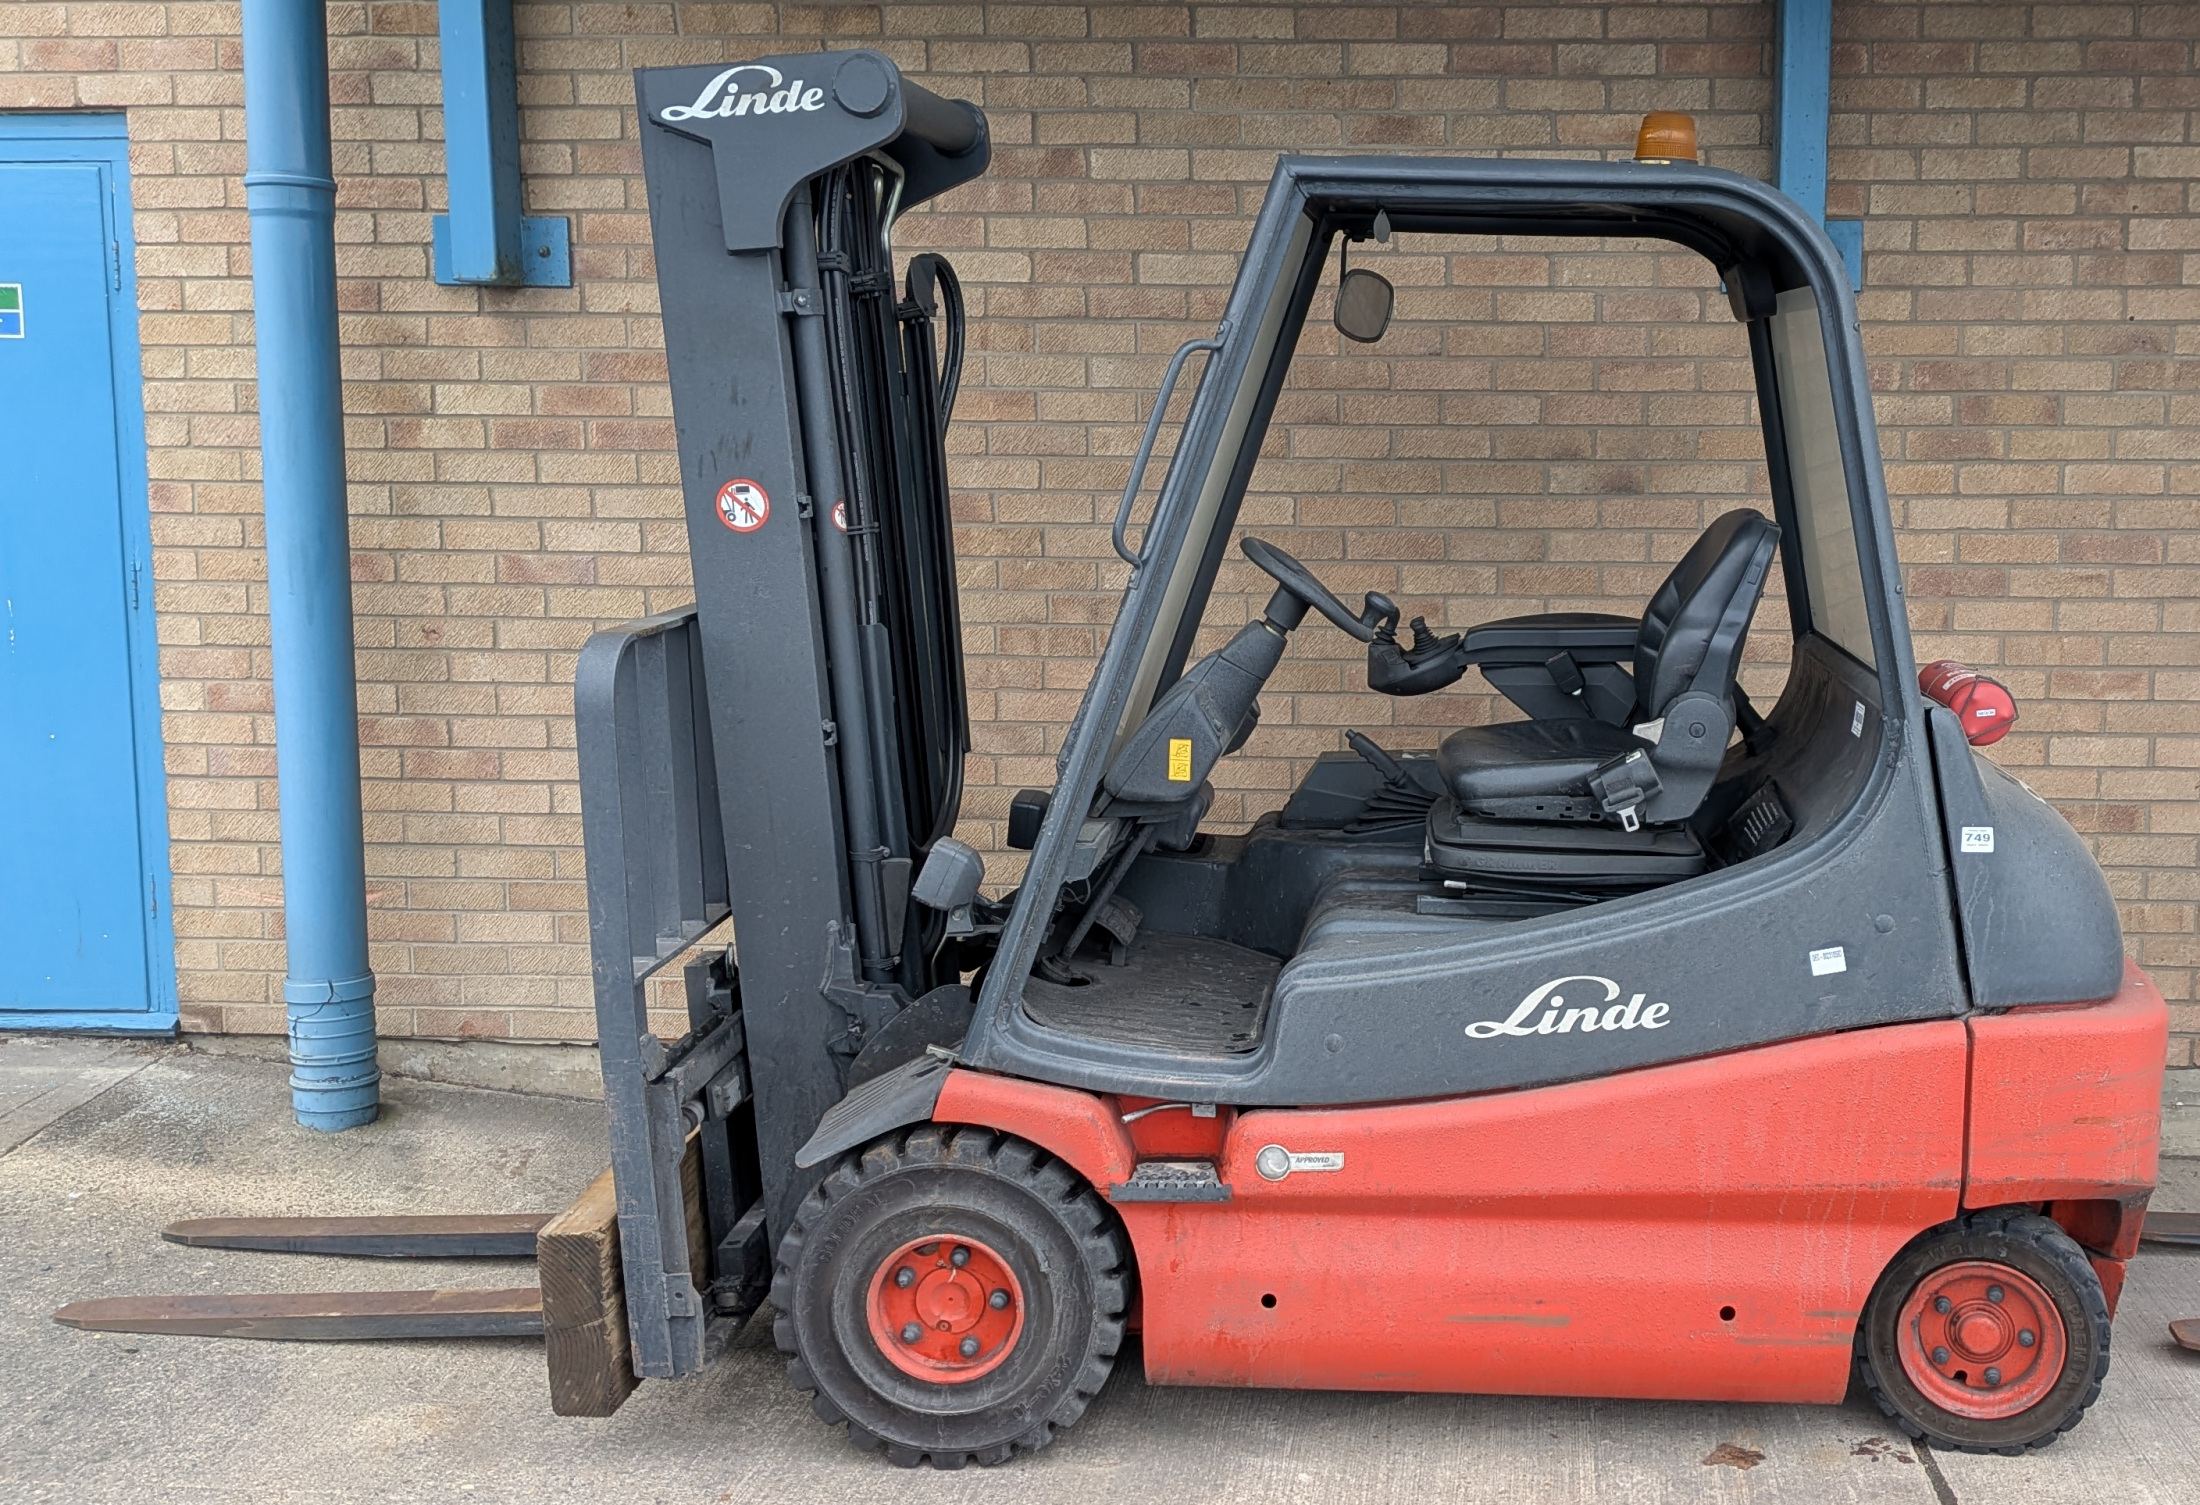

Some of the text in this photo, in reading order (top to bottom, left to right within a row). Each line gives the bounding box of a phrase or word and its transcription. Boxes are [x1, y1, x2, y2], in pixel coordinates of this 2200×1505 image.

[661, 65, 825, 121] Linde
[1965, 833, 1991, 842] 749
[1465, 975, 1670, 1038] Linde
